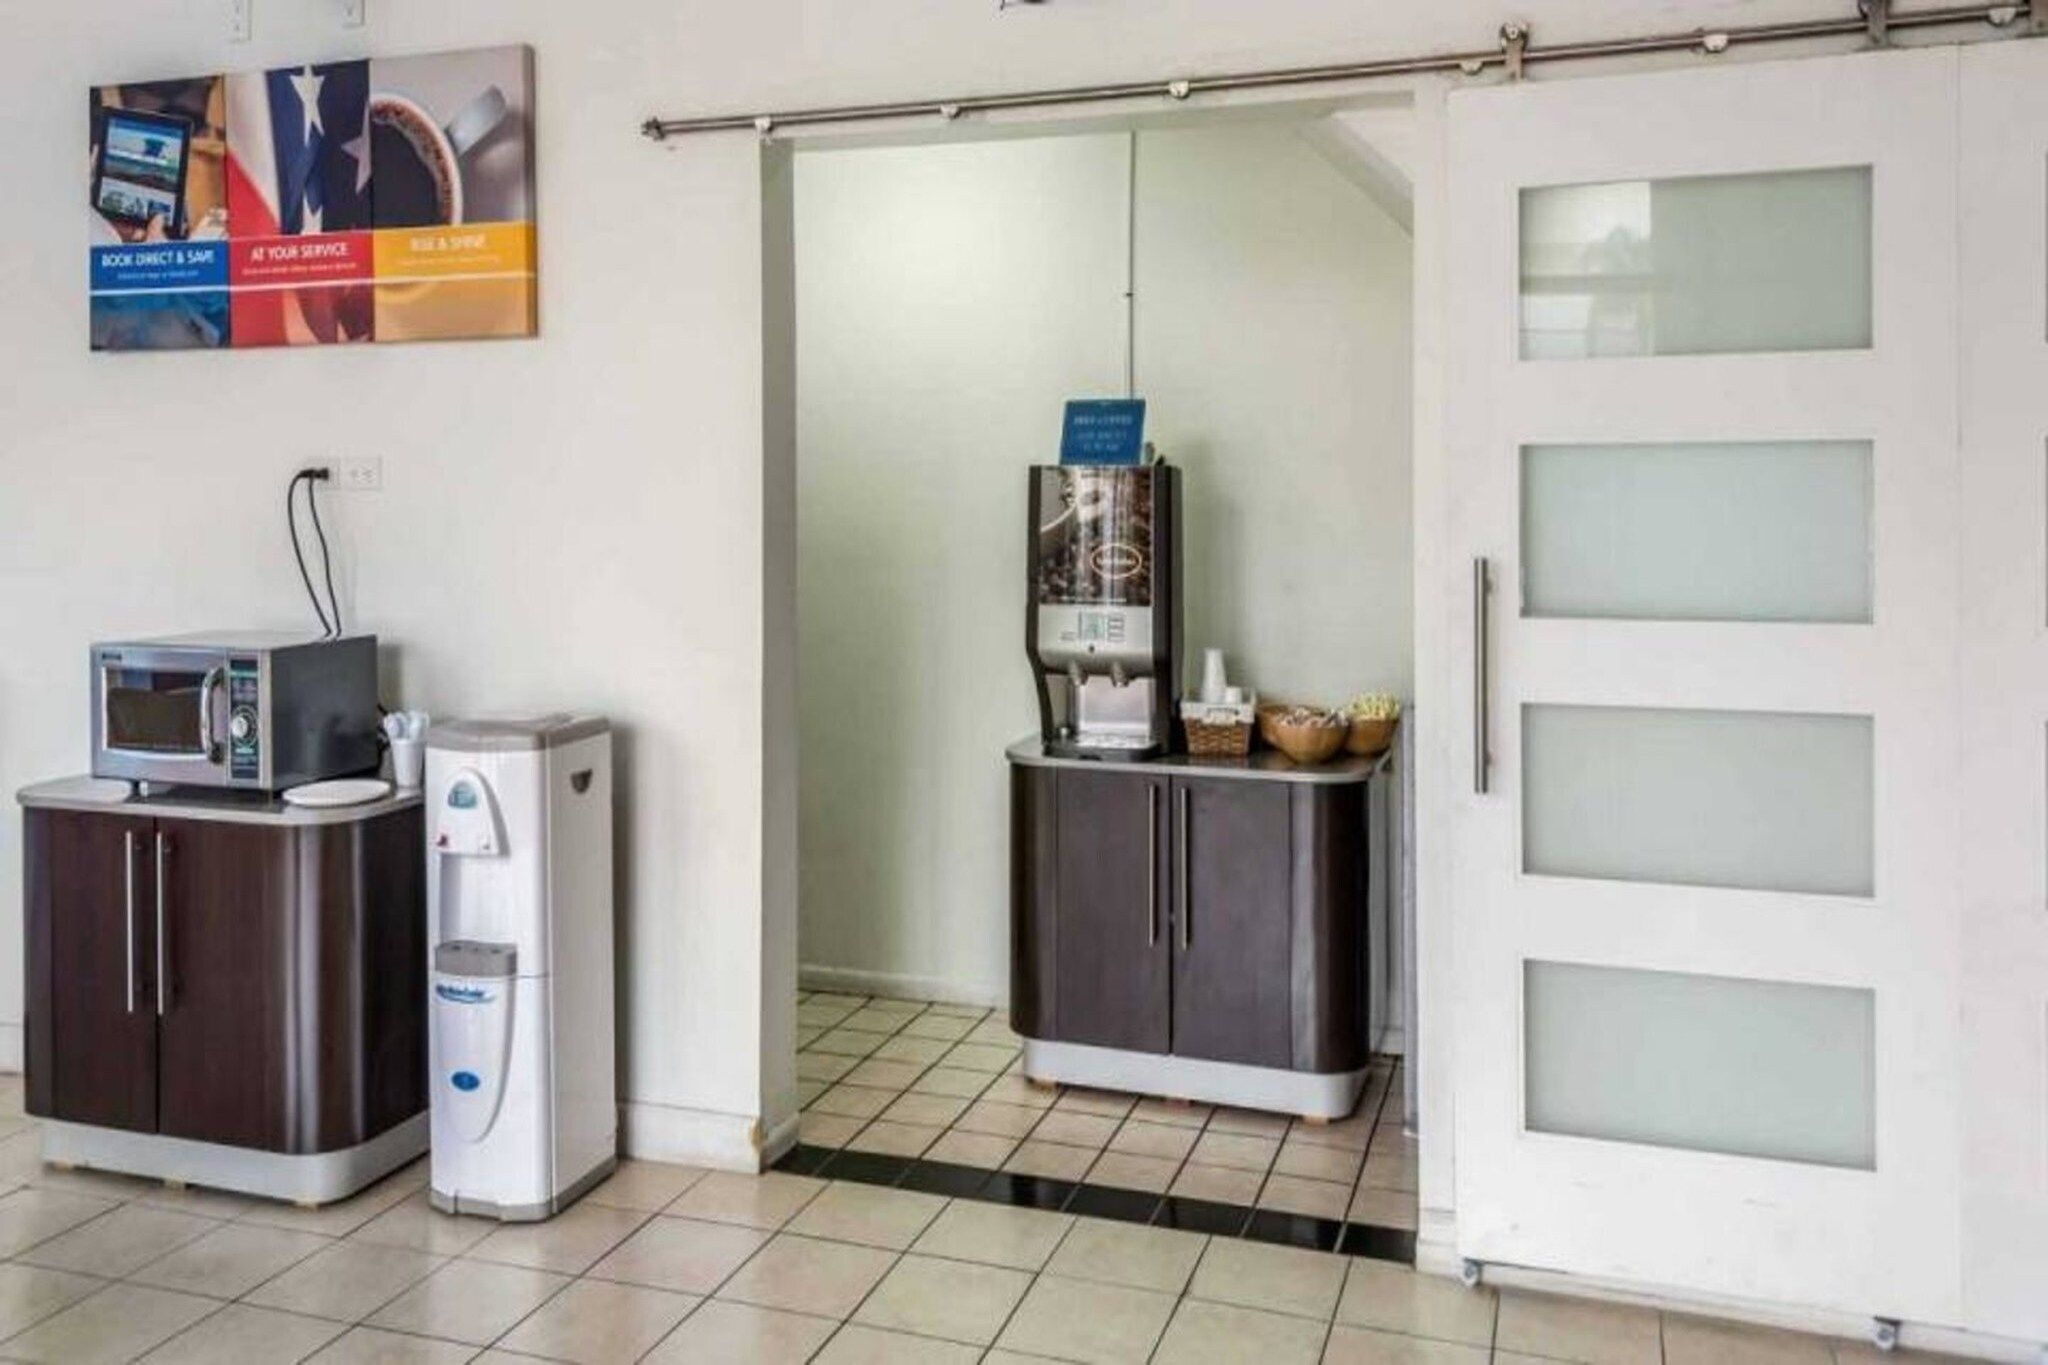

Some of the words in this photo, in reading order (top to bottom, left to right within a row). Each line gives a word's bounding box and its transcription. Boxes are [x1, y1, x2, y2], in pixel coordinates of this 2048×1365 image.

[102, 253, 133, 267] BOOK
[136, 251, 174, 266] DIRECT
[176, 250, 185, 264] &
[187, 250, 214, 264] SAVE
[251, 246, 265, 261] AT
[267, 245, 298, 260] YOUR
[300, 242, 348, 258] SERVICE
